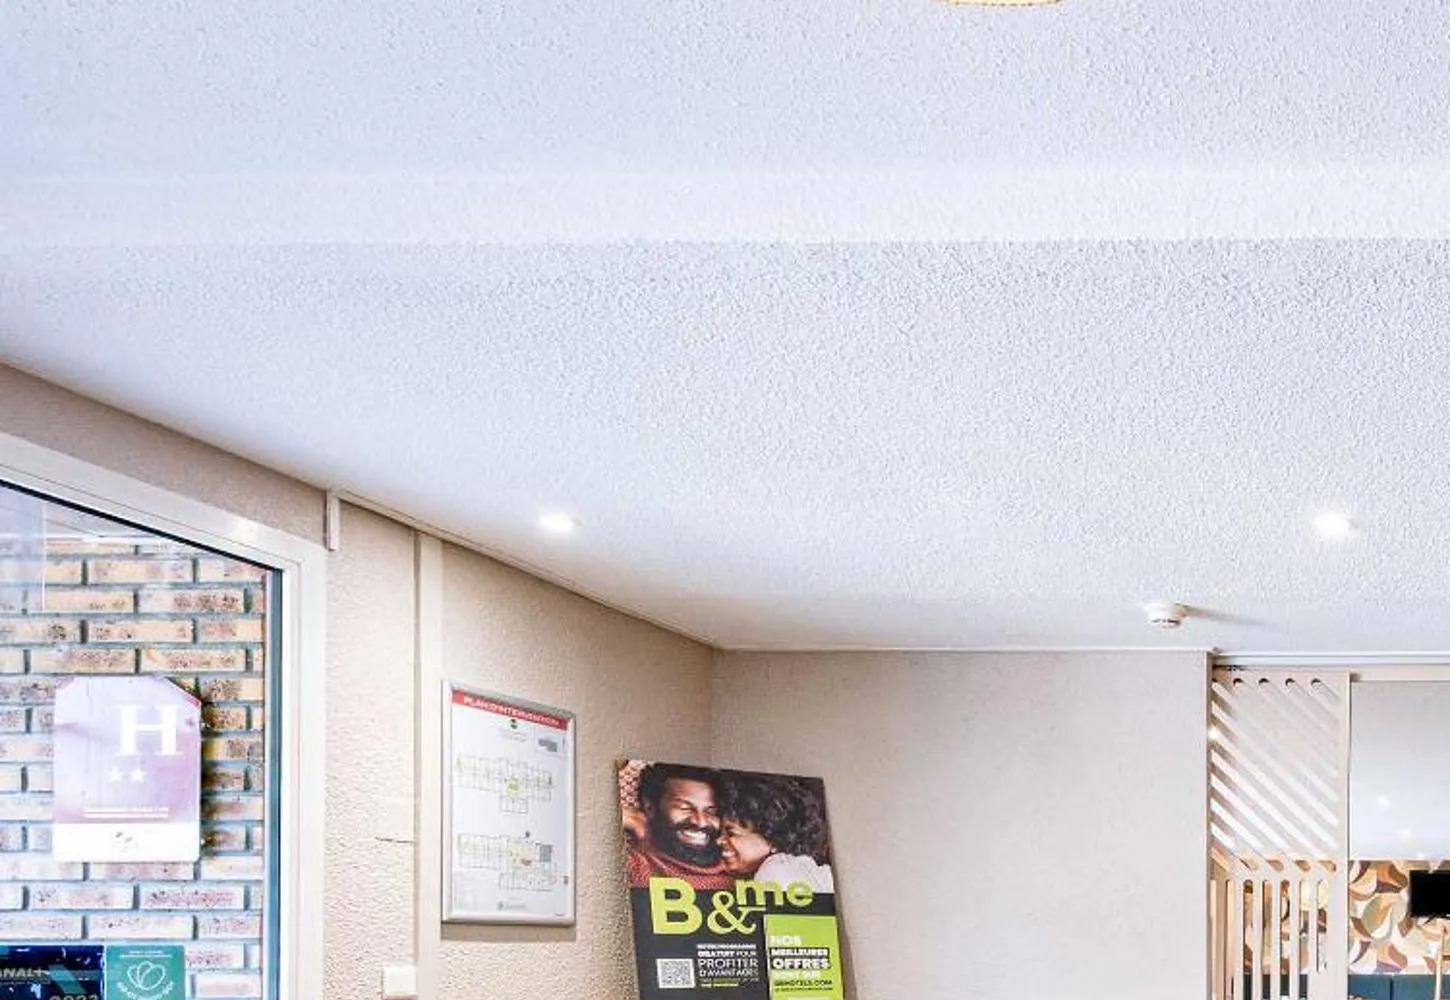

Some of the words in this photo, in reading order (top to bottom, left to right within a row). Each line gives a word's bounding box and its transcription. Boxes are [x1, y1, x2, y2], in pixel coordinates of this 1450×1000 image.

[116, 705, 183, 755] H
[698, 959, 760, 968] PROFITER
[772, 958, 830, 969] OFFRES
